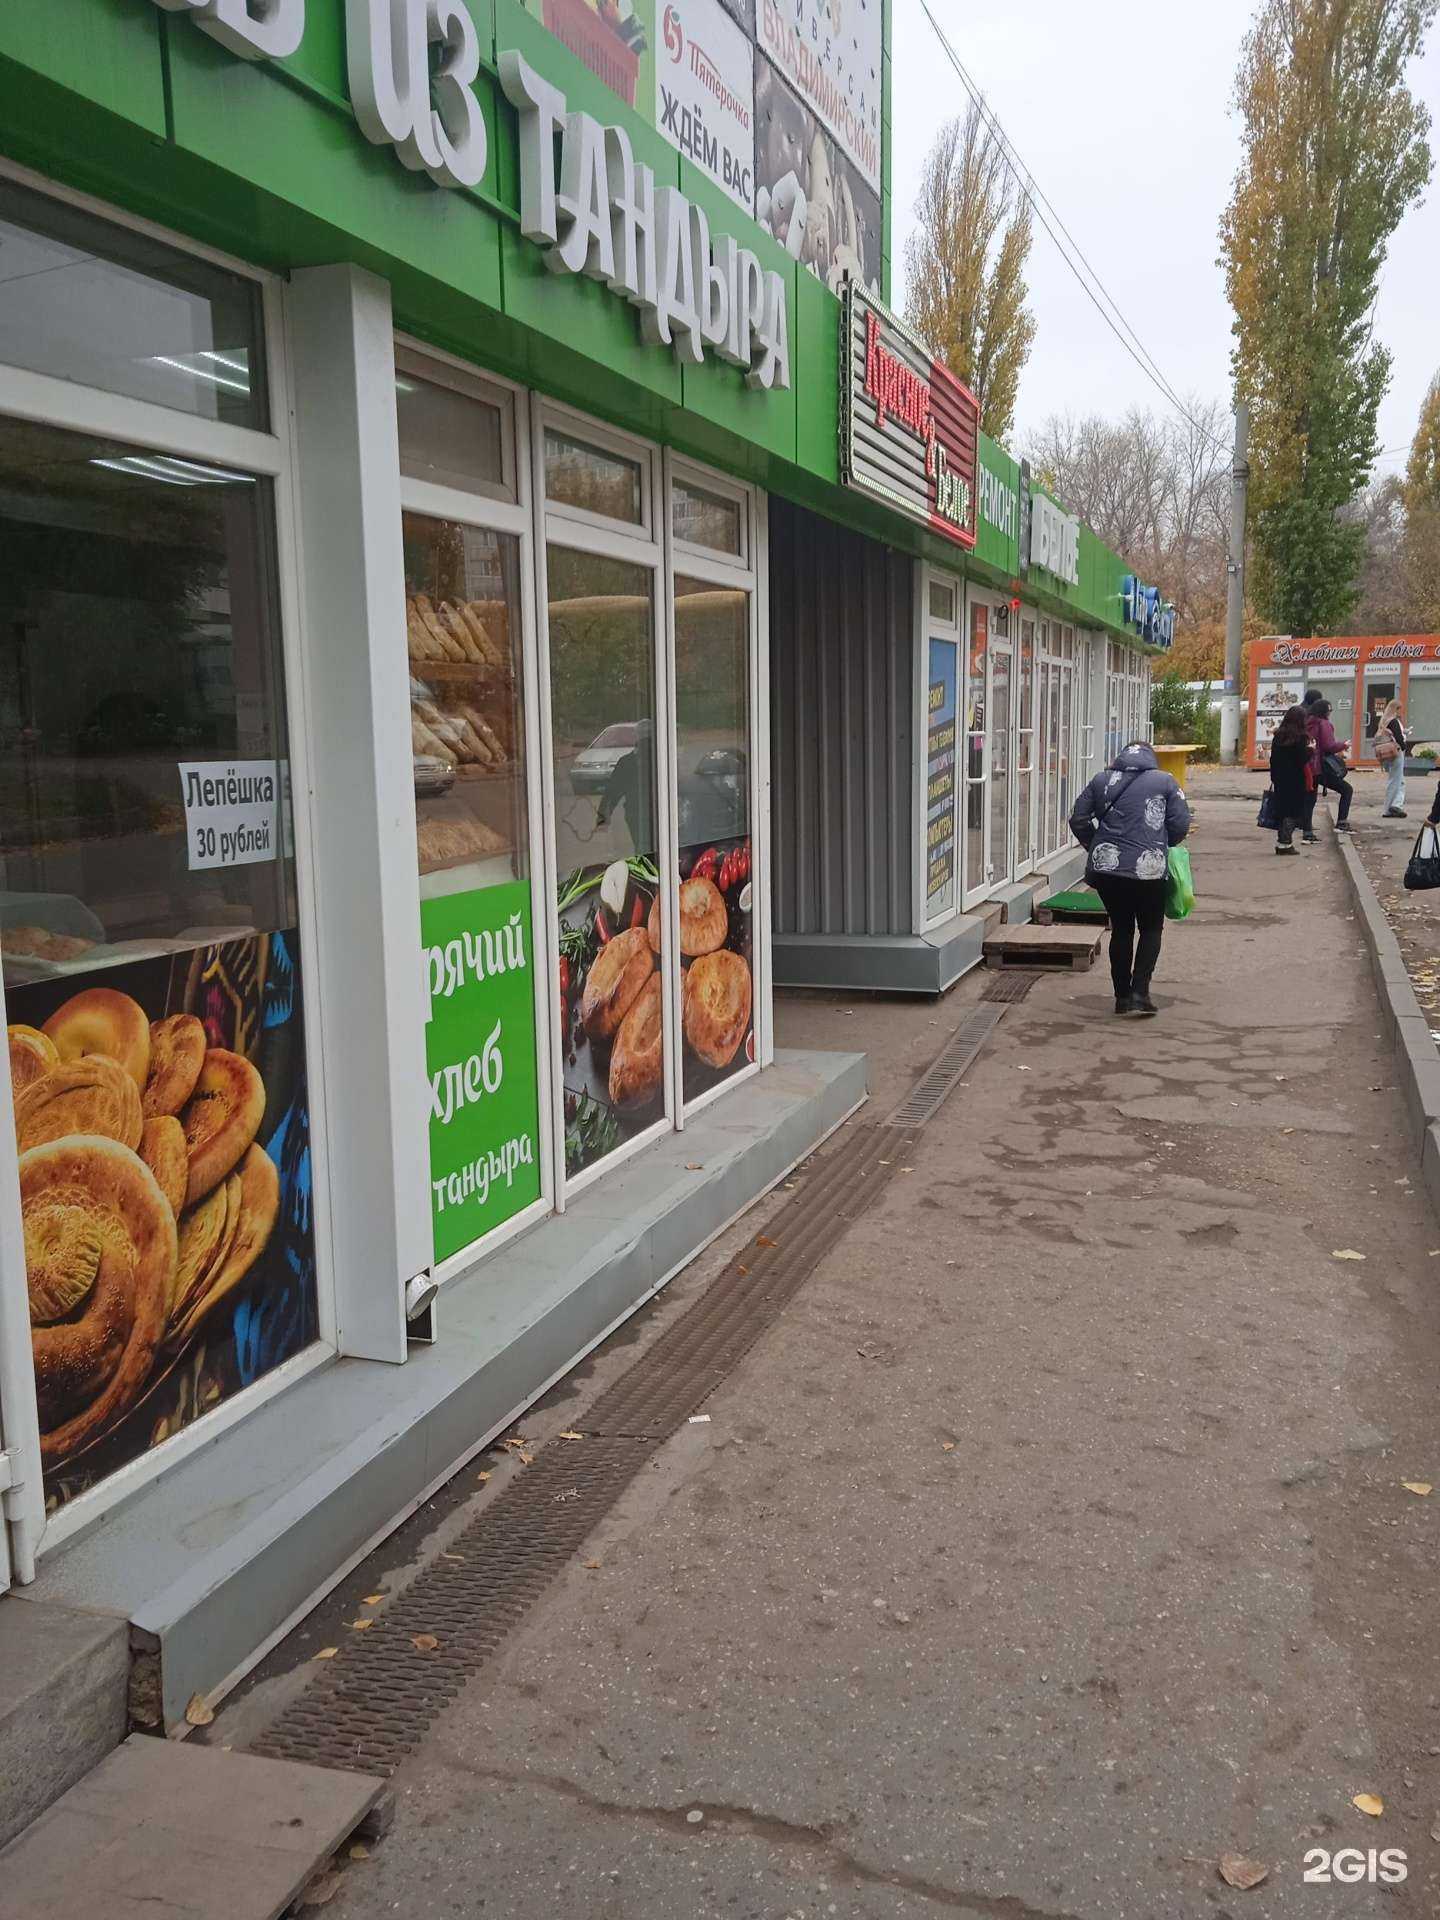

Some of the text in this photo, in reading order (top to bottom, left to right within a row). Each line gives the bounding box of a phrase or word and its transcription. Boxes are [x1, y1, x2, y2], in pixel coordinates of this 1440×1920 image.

[763, 0, 877, 177] ВЛАДИМИРСКИЙ
[660, 83, 751, 205] ЖДЁМ ВАС
[347, 0, 790, 390] ИЗ ТАНДЫРА
[865, 310, 931, 440] Красное
[978, 462, 1017, 541] РЕМОНТ
[1273, 640, 1425, 665] Хлебная лавка
[186, 768, 274, 808] Лепёшка
[196, 819, 270, 862] 30 рублей
[427, 1017, 503, 1124] хлеб
[432, 1133, 534, 1213] тандыра
